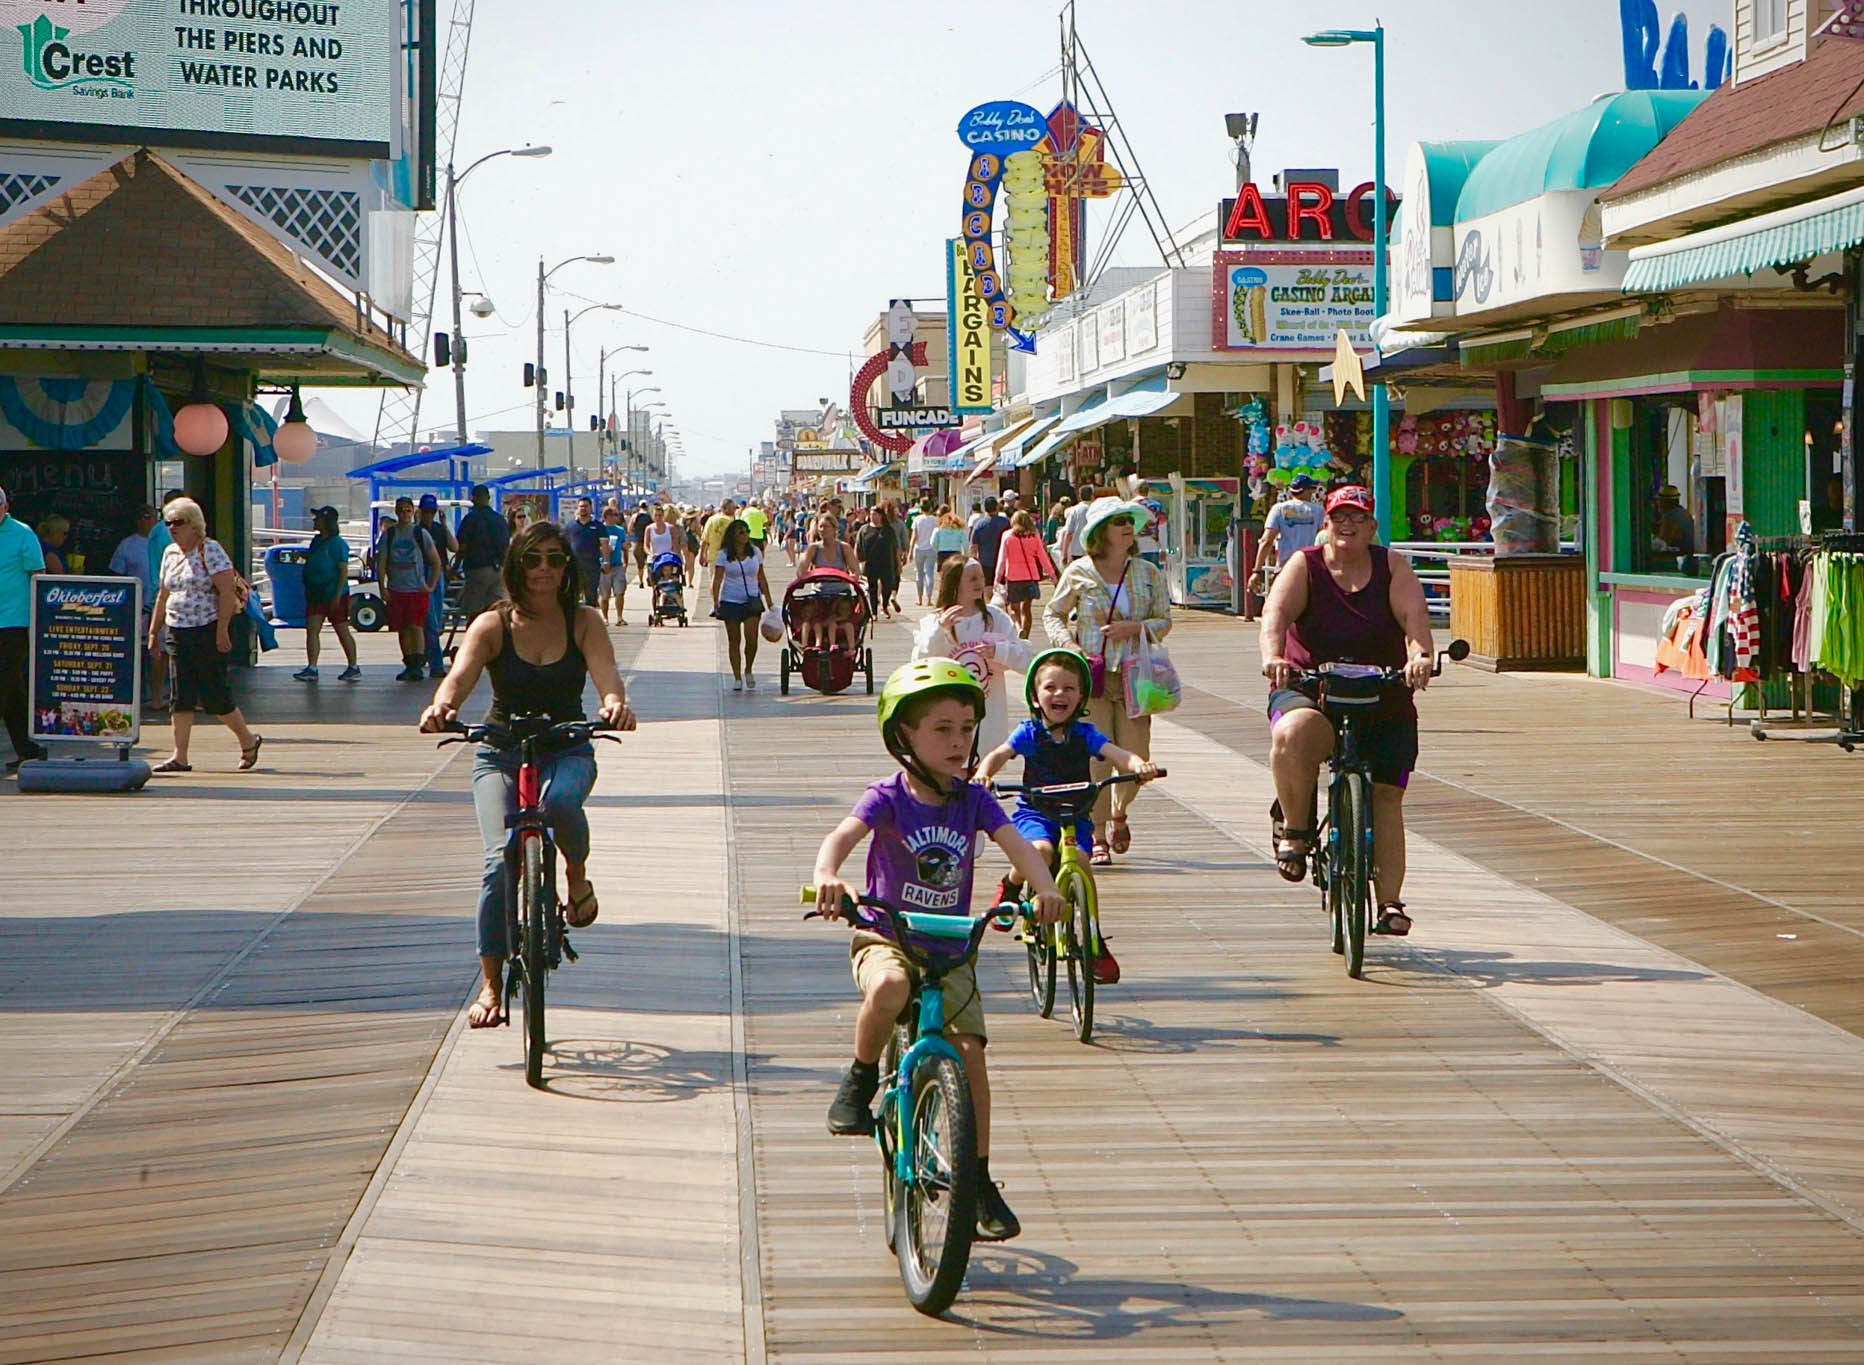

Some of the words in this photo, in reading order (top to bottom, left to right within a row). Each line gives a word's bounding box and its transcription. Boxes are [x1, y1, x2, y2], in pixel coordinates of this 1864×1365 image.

[179, 0, 340, 25] THROUGHOUT
[175, 27, 216, 50] THE
[224, 31, 285, 56] PIERS
[293, 37, 342, 60] AND
[42, 42, 135, 79] Crest
[180, 61, 258, 88] WATER
[266, 68, 338, 93] PARKS
[73, 85, 109, 99] Savings
[111, 88, 135, 98] Bank
[967, 128, 1041, 143] CASINO
[969, 157, 1006, 327] ARCADE
[1271, 287, 1326, 303] CASINO
[1330, 287, 1390, 305] ARCA
[1280, 307, 1320, 316] Skee-Ball
[1327, 307, 1352, 316] Photo
[1354, 307, 1376, 316] Boot
[1270, 333, 1294, 342] Crane
[1297, 333, 1325, 342] Games
[881, 410, 959, 425] FUNCADE
[47, 587, 124, 607] Oktoberfest
[904, 886, 958, 907] RAVENS
